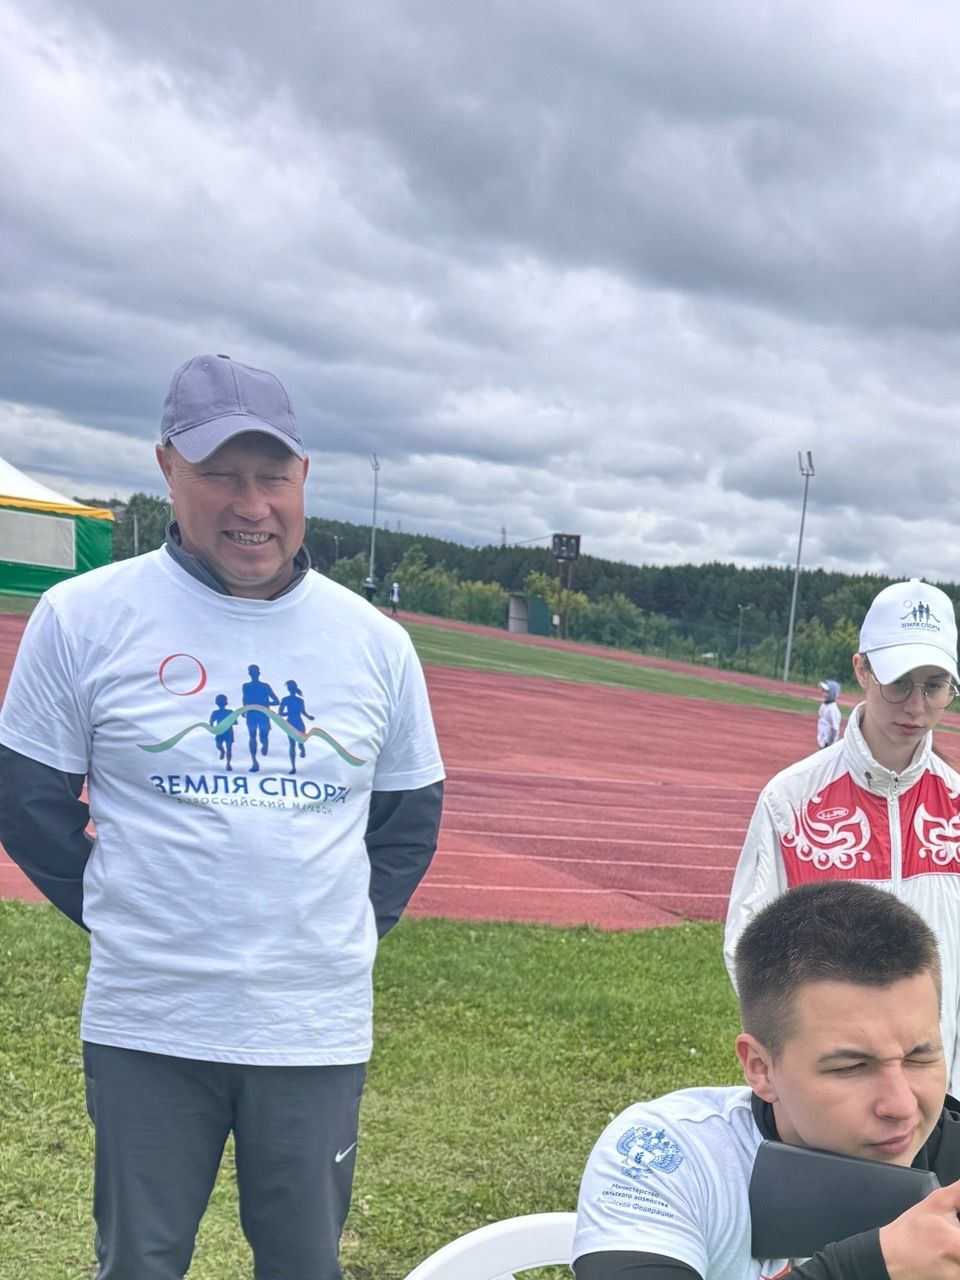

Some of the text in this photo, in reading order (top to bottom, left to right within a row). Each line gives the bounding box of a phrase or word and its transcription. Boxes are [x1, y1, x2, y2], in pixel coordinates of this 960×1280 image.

[150, 774, 352, 803] ЗЕМЛЯ СПОРТА
[177, 796, 286, 809] РОССИЙСКИЙ
[611, 1183, 660, 1199] Министерство
[632, 1203, 674, 1218] Федерации
